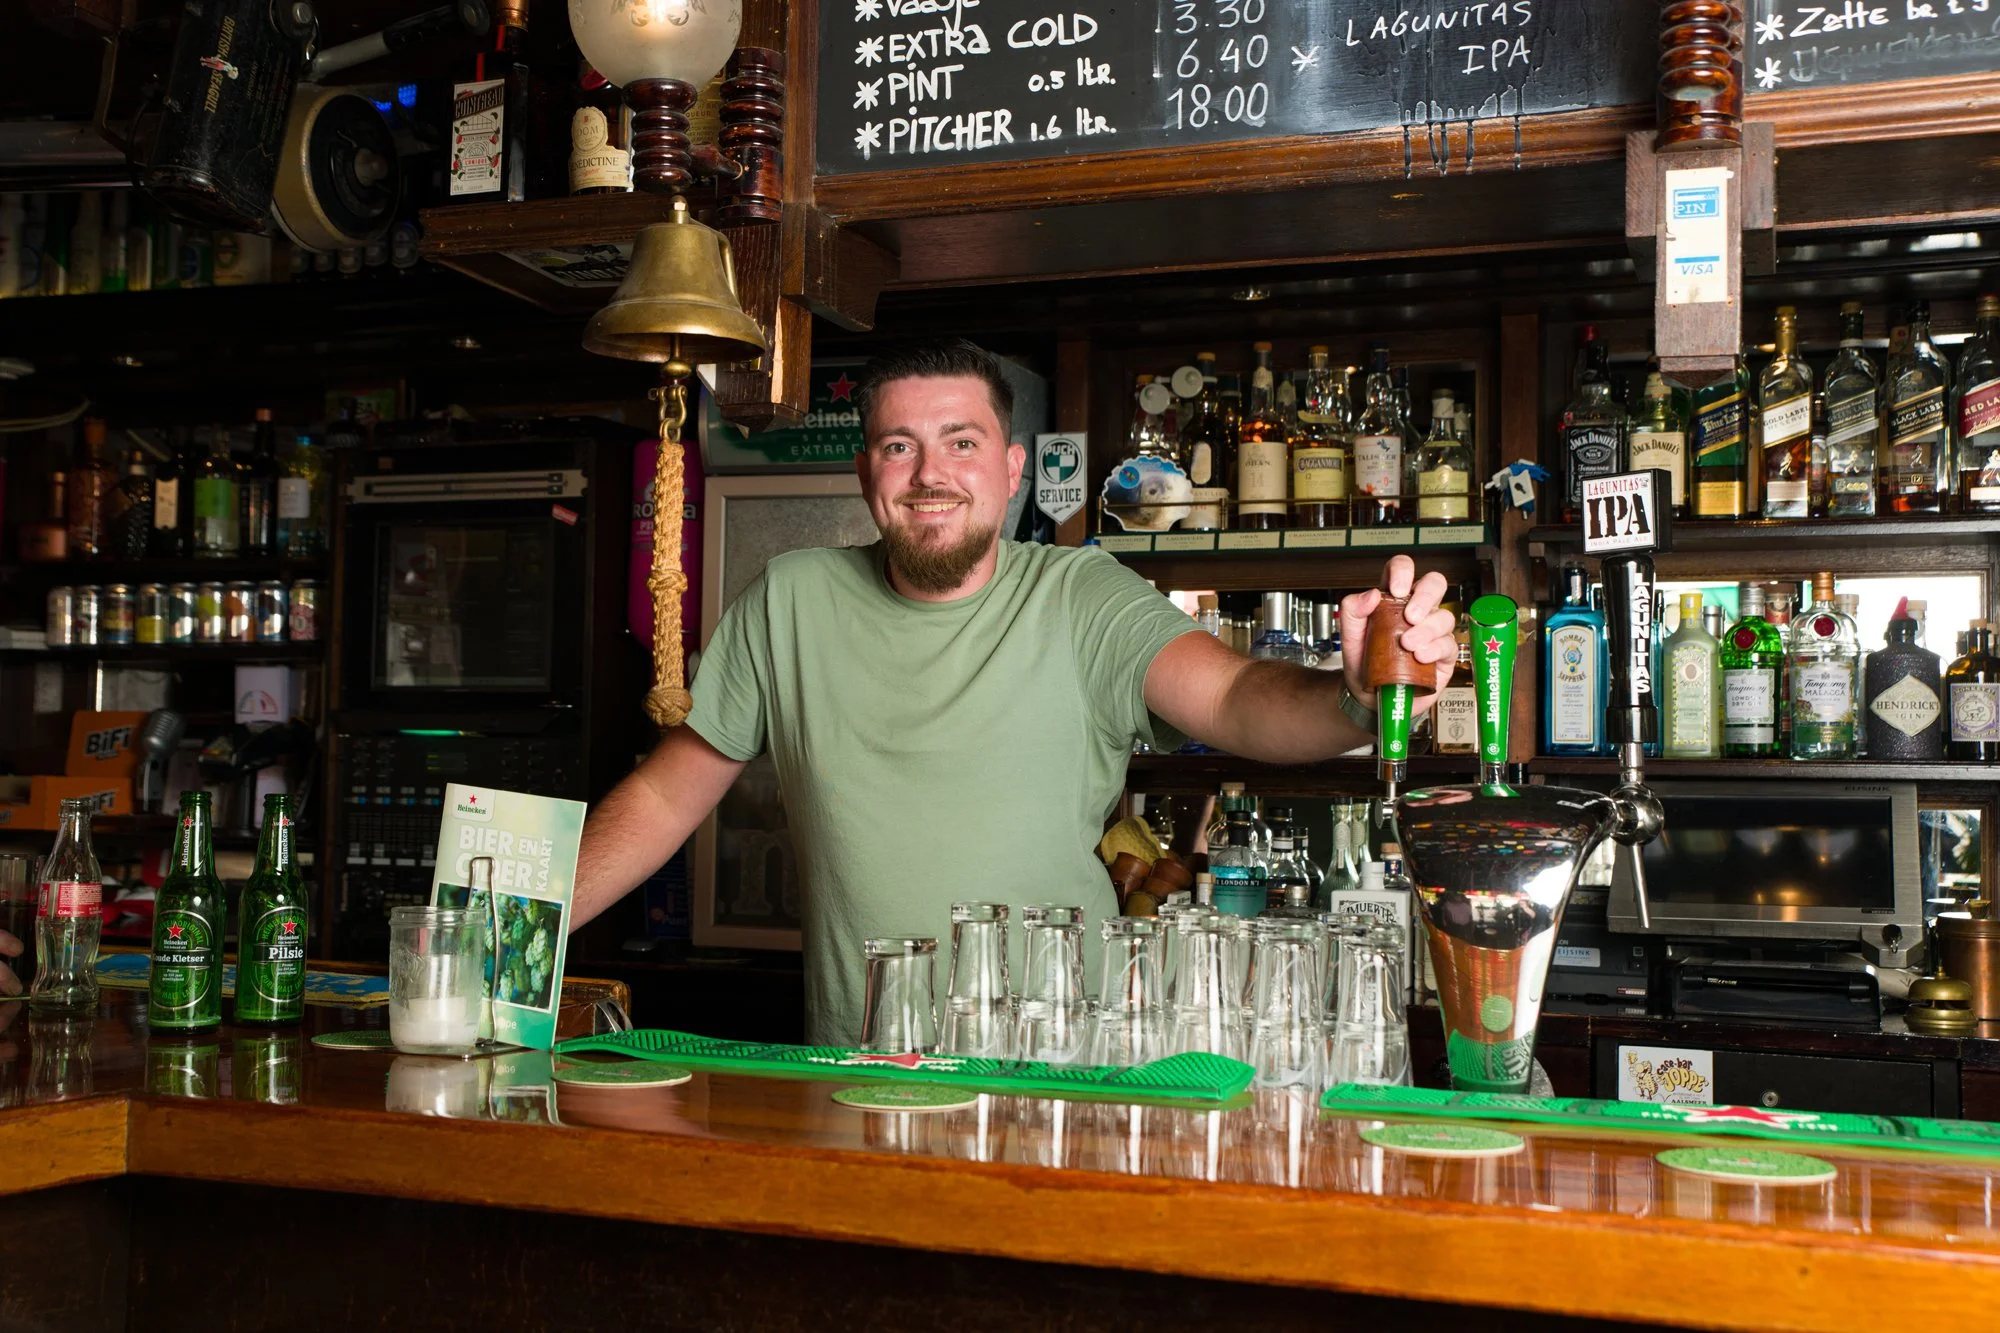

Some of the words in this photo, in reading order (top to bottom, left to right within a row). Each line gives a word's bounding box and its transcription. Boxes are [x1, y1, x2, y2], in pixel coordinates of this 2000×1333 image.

[1007, 13, 1098, 48] COLD
[1177, 34, 1269, 79] 6.40
[1458, 35, 1532, 75] IPA
[204, 69, 224, 114] SEAGULL
[1028, 70, 1066, 92] 0.5
[686, 109, 711, 117] QUEUR
[1167, 83, 1269, 130] 18.00
[1031, 115, 1062, 141] 1.6
[1675, 202, 1707, 214] PIN
[1681, 264, 1714, 276] VISA
[789, 407, 861, 429] einek
[1965, 402, 1984, 416] RED
[1763, 415, 1784, 427] GOLD
[791, 444, 845, 456] EXTRA
[1045, 445, 1075, 456] PUCH
[1570, 435, 1588, 450] JACK
[1633, 442, 1651, 456] JACK
[1040, 488, 1081, 503] SERVICE
[1588, 478, 1639, 496] LAGUNITAS
[1587, 493, 1651, 539] IPA
[1631, 572, 1651, 693] LAGUNITAS
[1486, 657, 1500, 723] Heineken
[1727, 683, 1767, 694] Tanquey
[457, 804, 486, 815] Heineken
[182, 829, 190, 866] Heineken
[459, 824, 514, 856] BIER
[519, 838, 538, 857] EN
[455, 853, 533, 889] CIDER
[535, 836, 553, 892] KAART
[172, 954, 204, 962] Kletser
[268, 946, 303, 959] Pilsie
[1661, 1068, 1705, 1092] JOPPE
